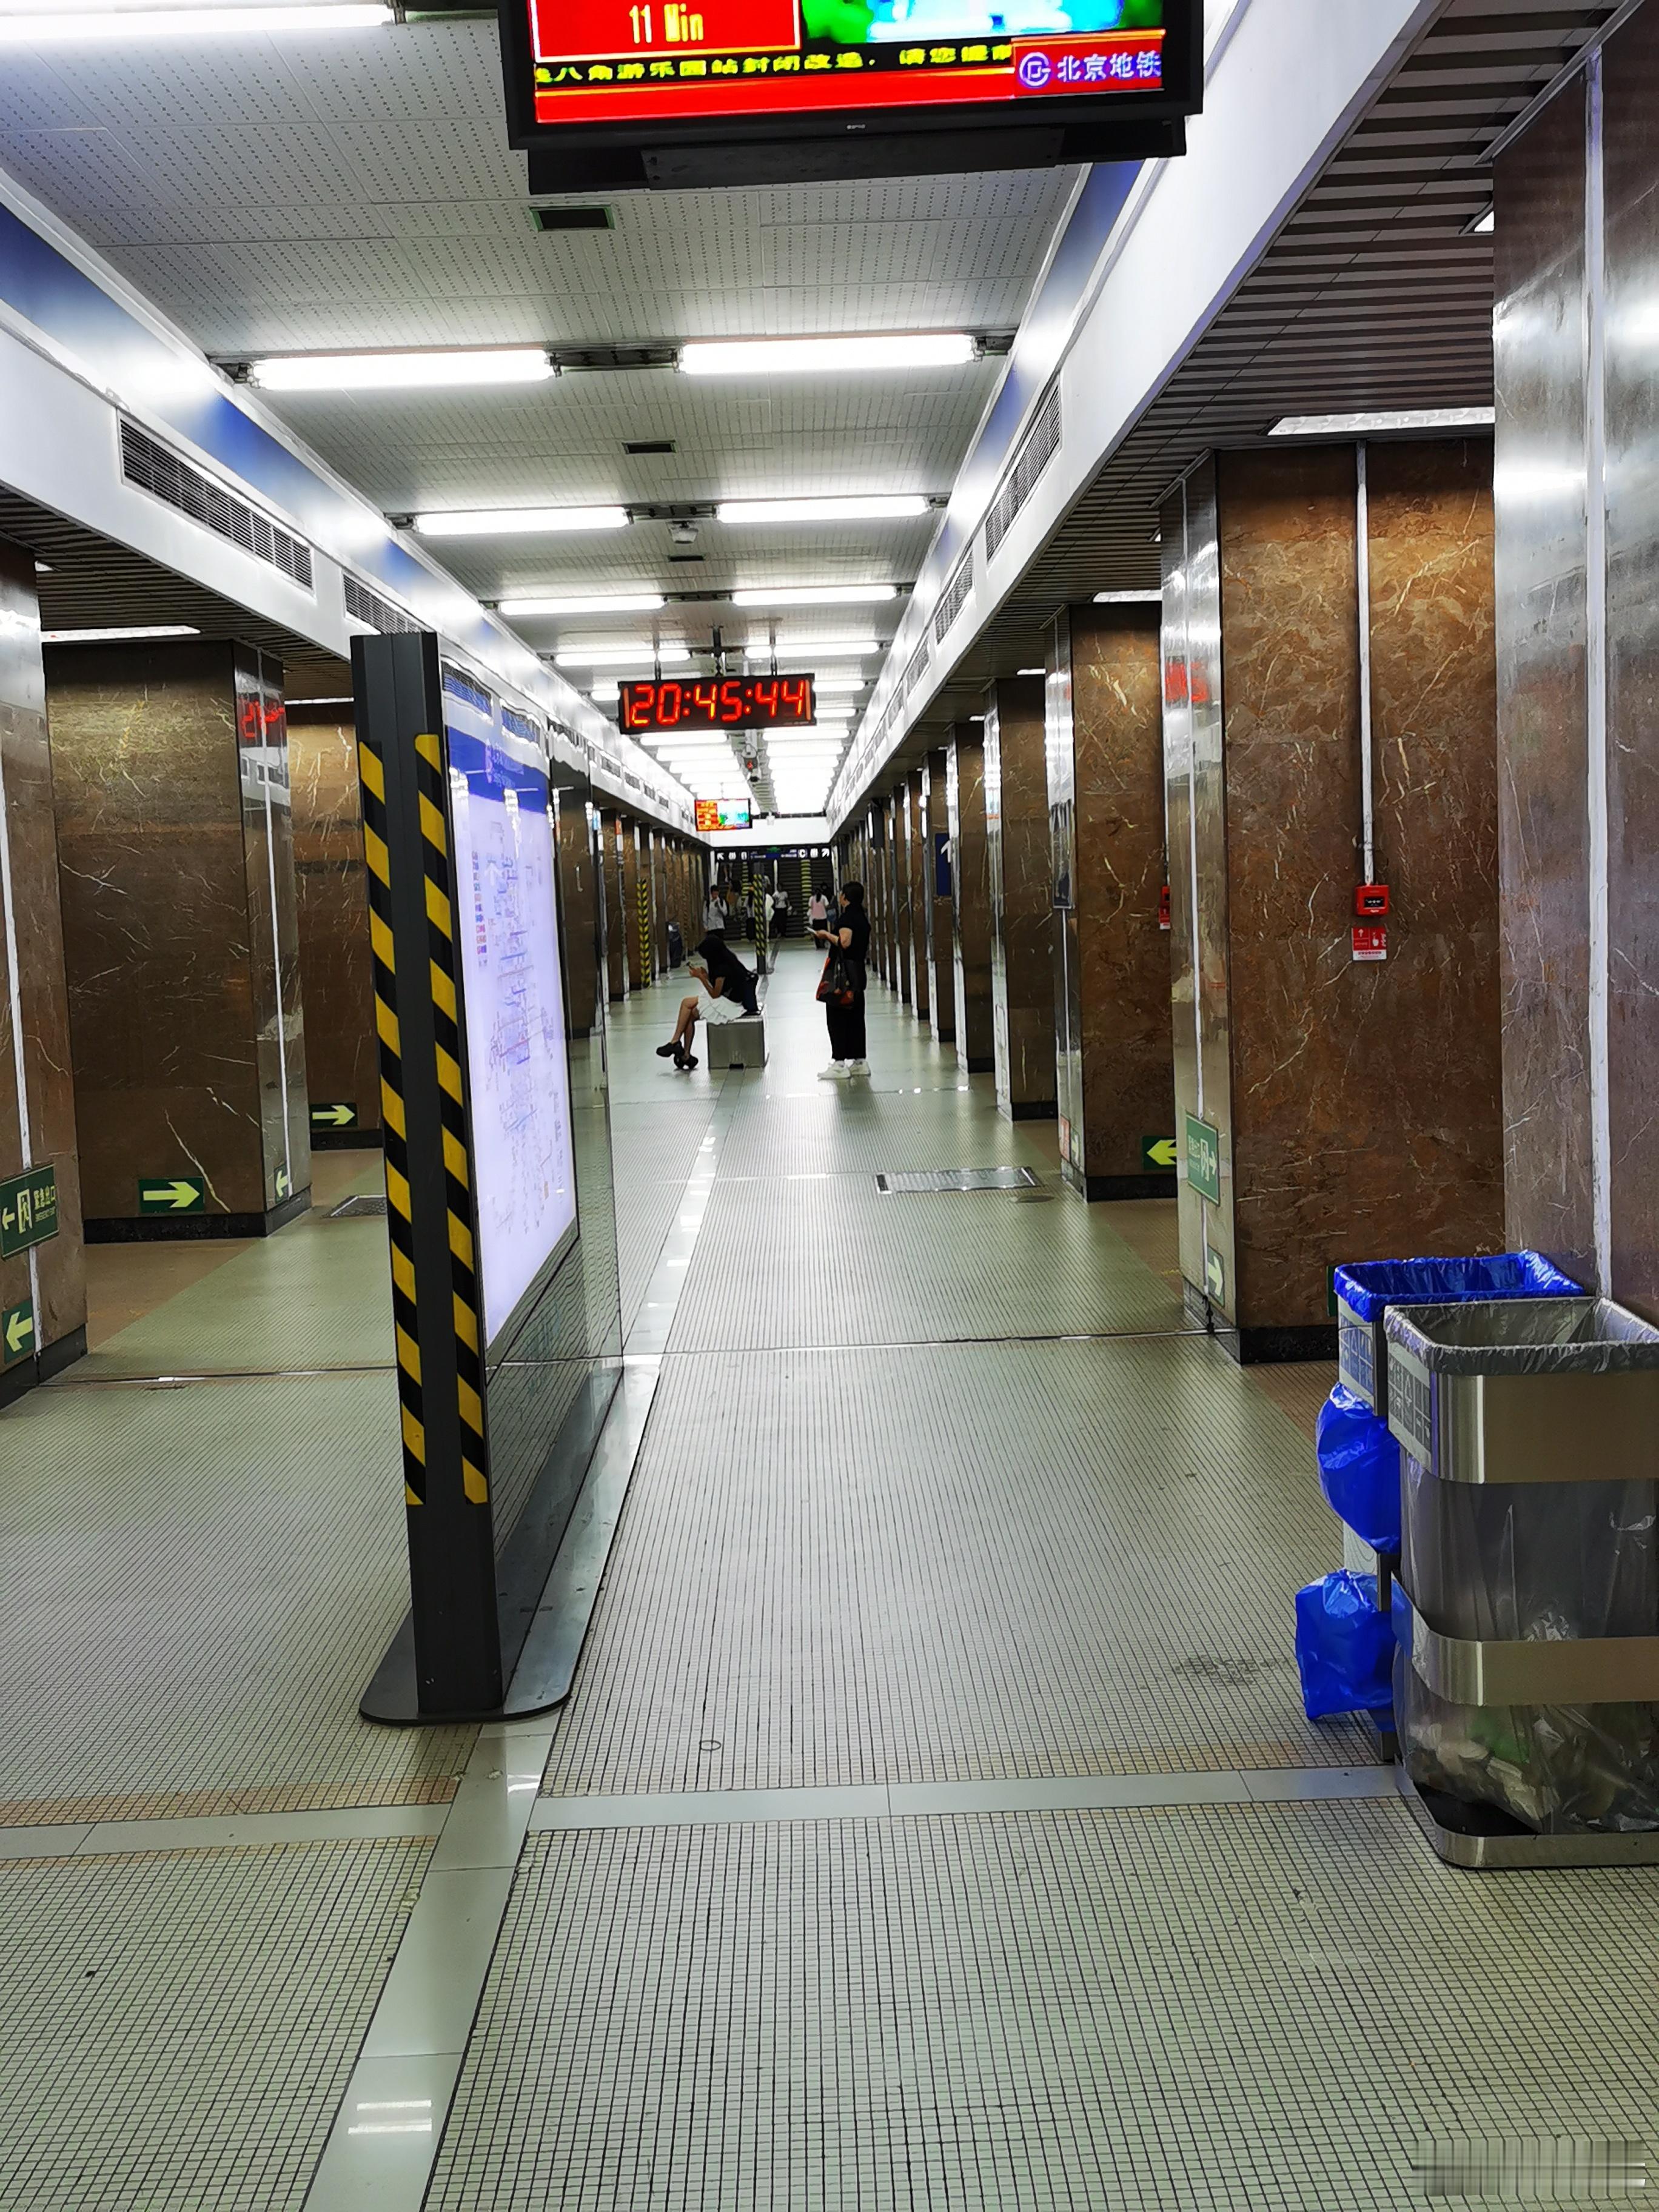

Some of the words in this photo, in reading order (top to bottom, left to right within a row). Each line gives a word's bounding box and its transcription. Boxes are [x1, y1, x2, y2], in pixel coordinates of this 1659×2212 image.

[629, 4, 652, 44] 11
[664, 3, 704, 42] Min
[1057, 50, 1161, 82] 北京地铁
[631, 680, 804, 725] 20:45:44
